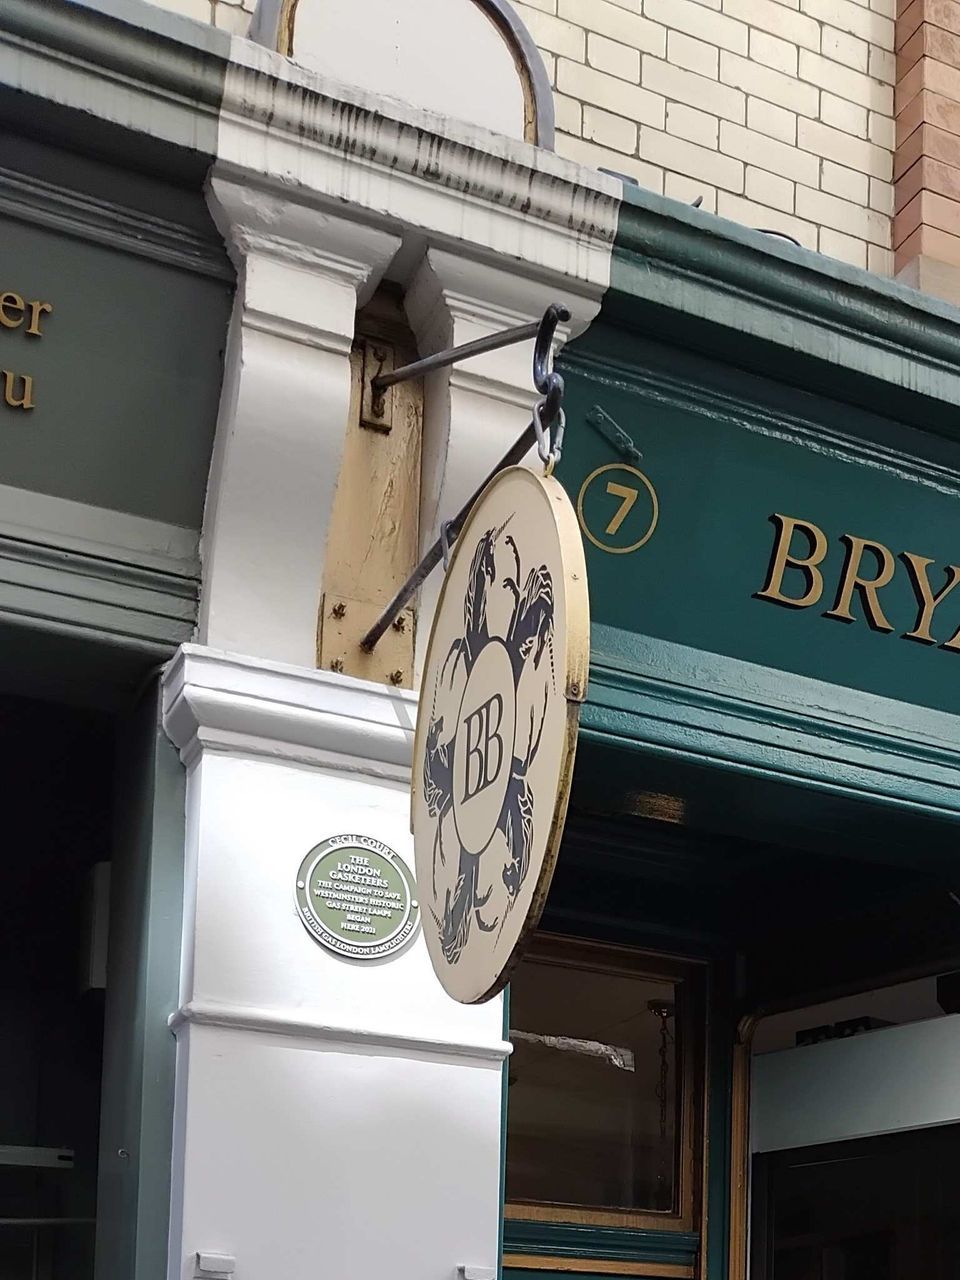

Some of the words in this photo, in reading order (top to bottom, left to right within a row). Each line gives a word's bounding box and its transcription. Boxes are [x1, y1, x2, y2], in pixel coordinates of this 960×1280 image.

[0, 292, 53, 336] er
[2, 370, 36, 409] u
[605, 481, 639, 535] 7
[461, 693, 503, 805] BB
[328, 834, 360, 848] CECIL
[360, 837, 397, 859] COURT
[337, 862, 381, 877] LONDON
[349, 855, 370, 866] THE
[329, 870, 389, 888] GASKETEERS
[317, 880, 333, 890] THE
[333, 882, 373, 896] CAMPAIGN
[373, 889, 384, 898] TO
[384, 891, 402, 901] SAVE
[326, 901, 341, 911] GAS
[341, 903, 369, 914] STREET
[368, 906, 392, 918] LAMPS
[370, 897, 405, 911] HISTORIC
[340, 922, 360, 932] HERE
[346, 914, 371, 924] BEGAN
[302, 907, 323, 938] BRITISH
[322, 932, 337, 947] GAS
[336, 941, 371, 955] LONDON
